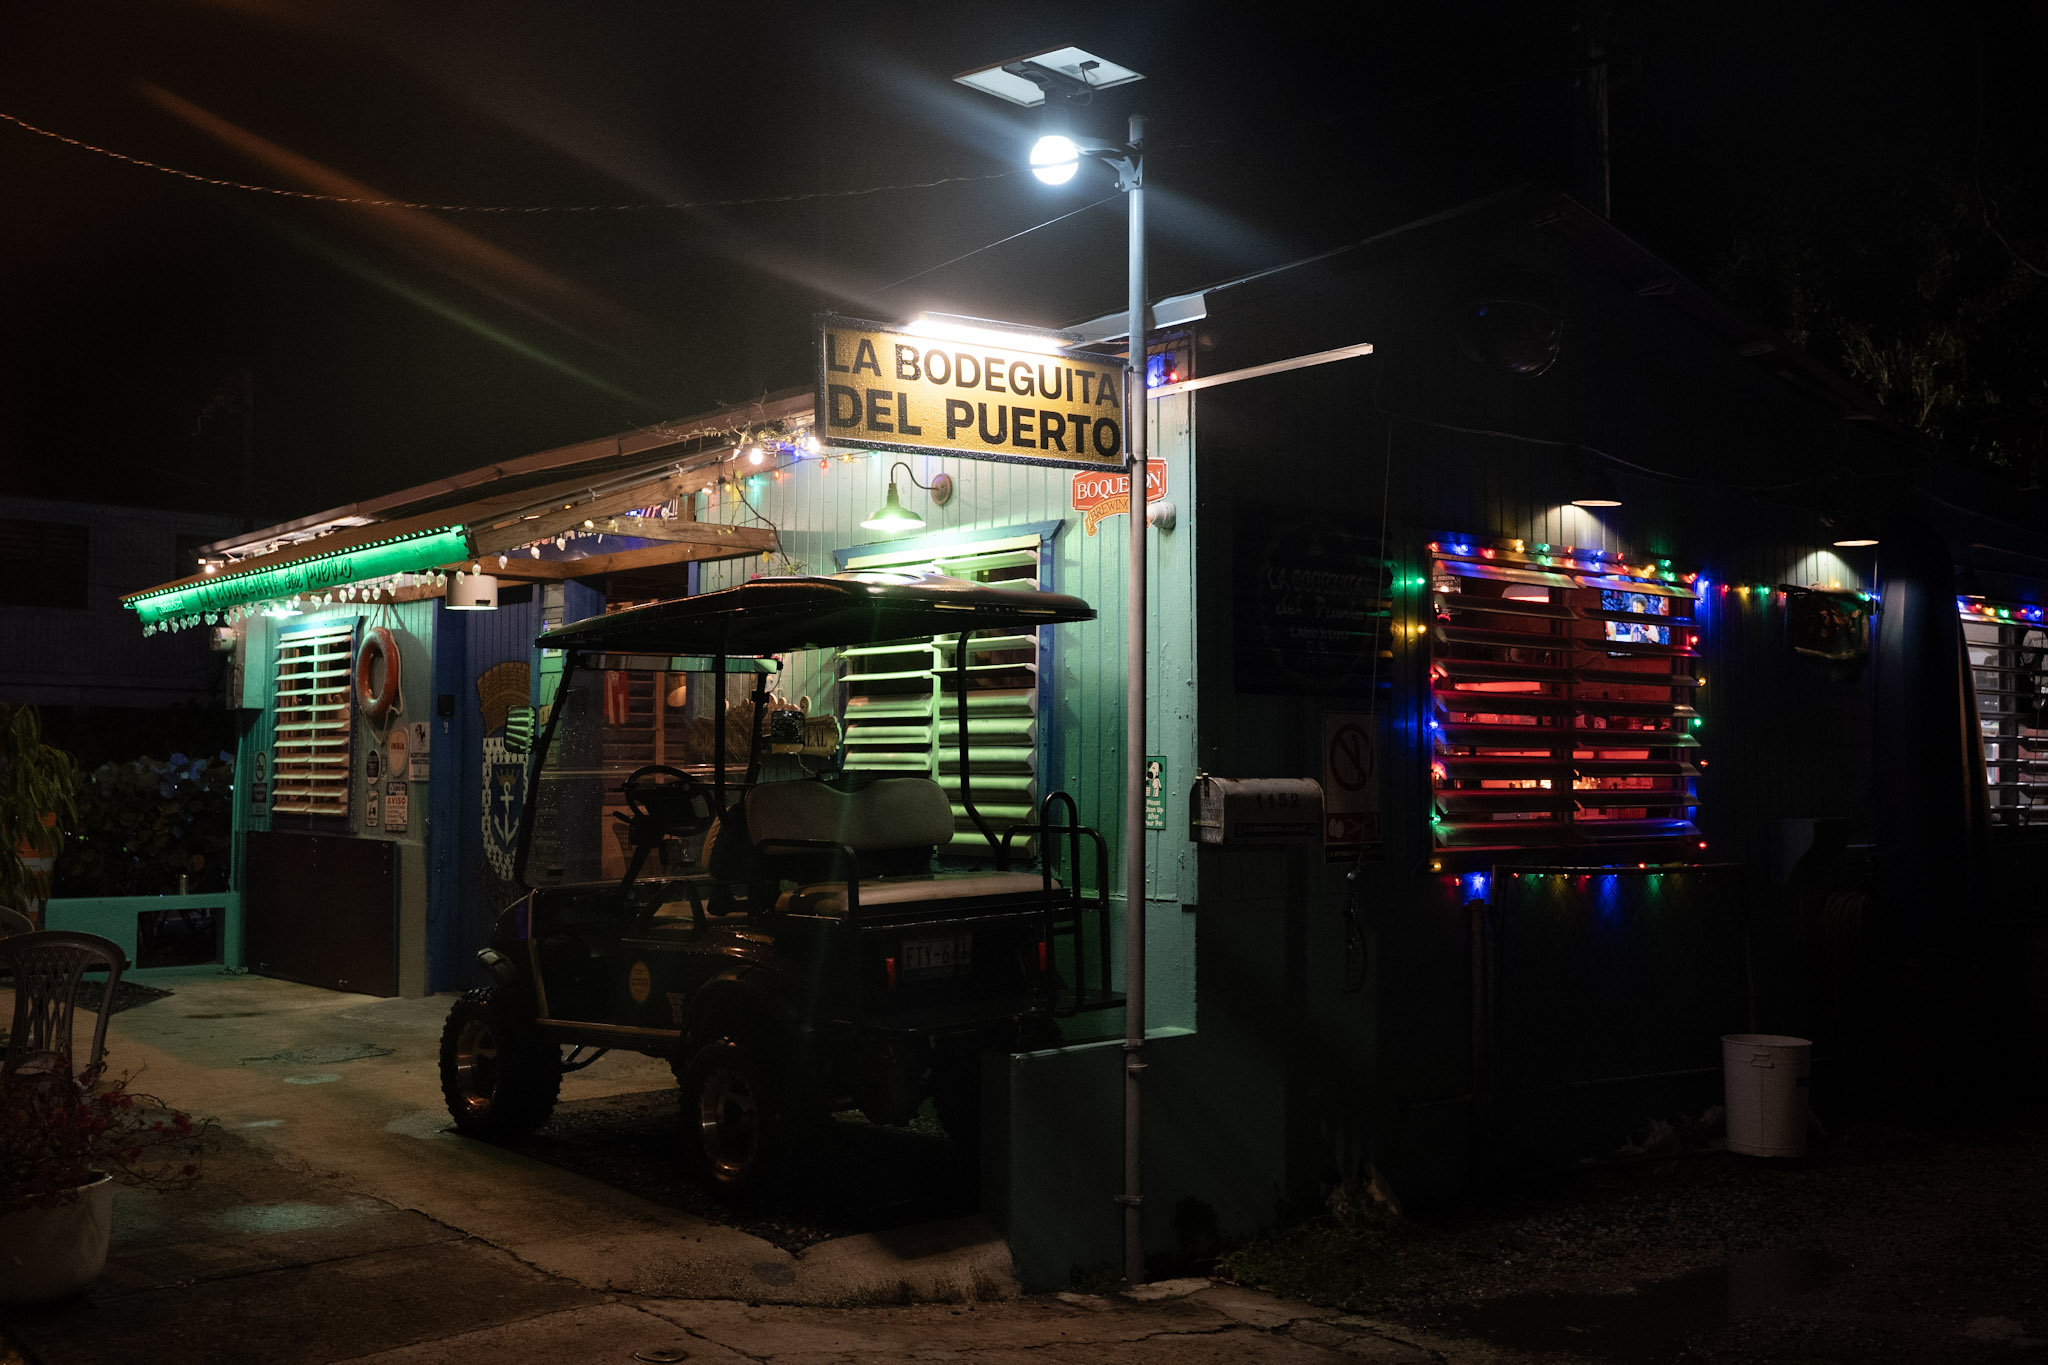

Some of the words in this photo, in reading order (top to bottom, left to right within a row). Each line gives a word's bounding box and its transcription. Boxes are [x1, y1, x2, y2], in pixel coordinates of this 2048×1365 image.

[826, 334, 882, 377] LA
[895, 343, 1121, 409] BODEGUITA
[827, 383, 922, 436] DEL
[945, 397, 1122, 458] PUERTO
[1077, 470, 1162, 500] BOQUEN
[387, 796, 406, 805] AVISO
